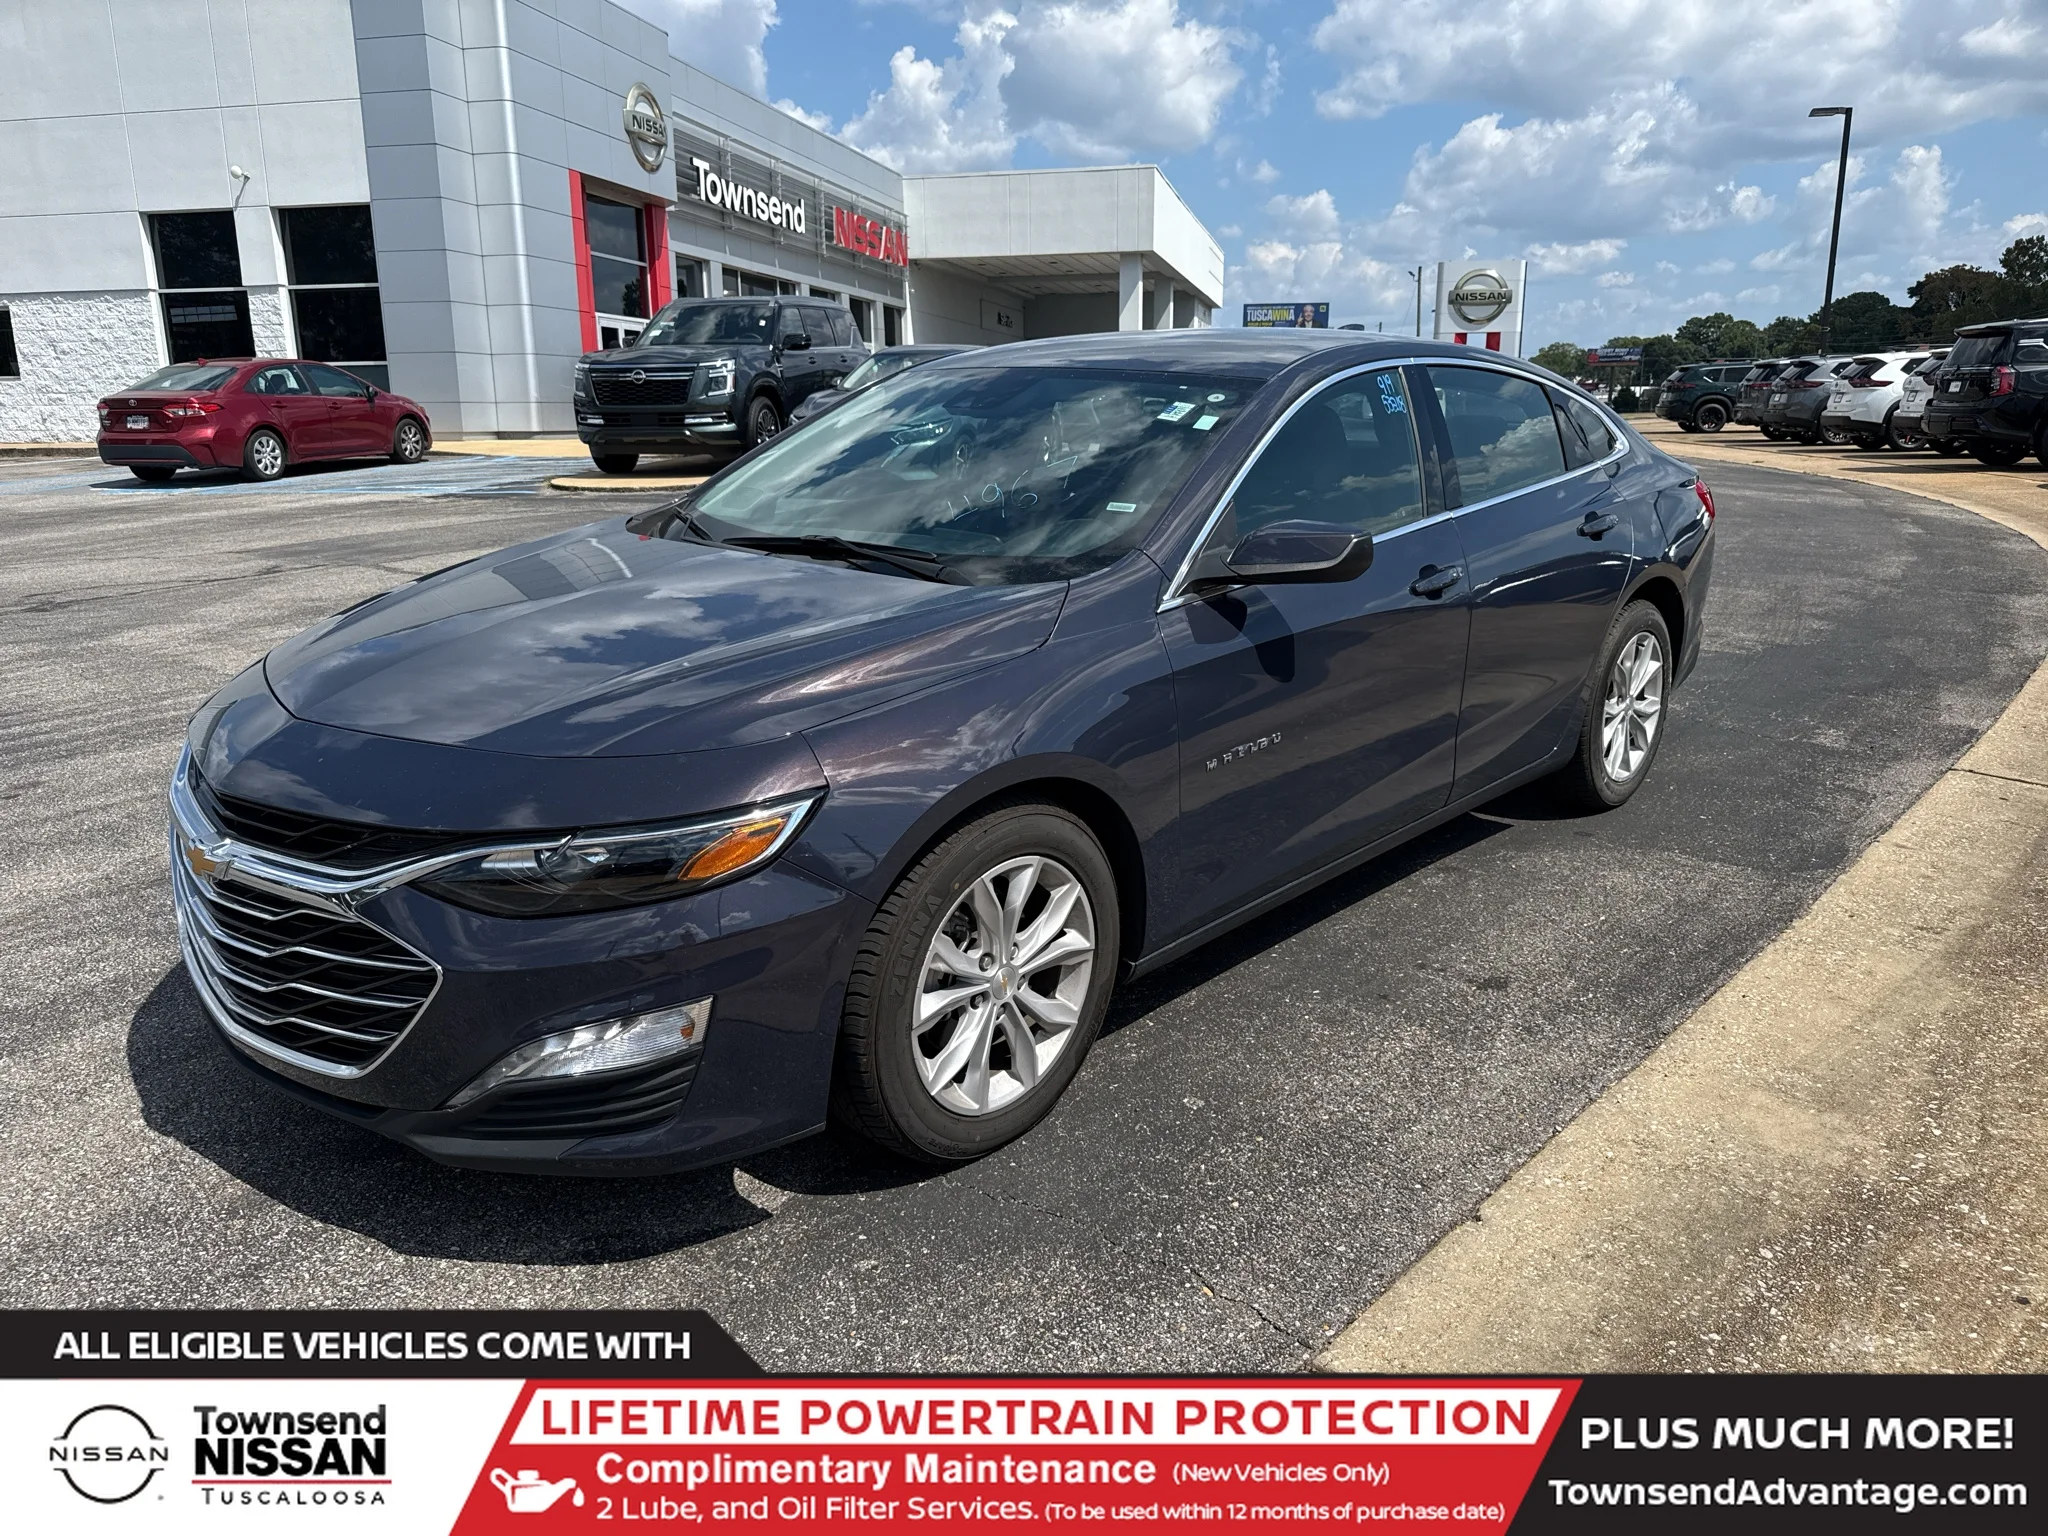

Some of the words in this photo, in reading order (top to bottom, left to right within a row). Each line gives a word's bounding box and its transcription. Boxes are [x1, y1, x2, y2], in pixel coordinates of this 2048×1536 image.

[691, 157, 806, 234] Townsend
[833, 206, 908, 268] NISSAN
[1246, 309, 1295, 322] TUSCAWINA
[1455, 292, 1507, 302] NISSAN
[1206, 732, 1282, 772] MALIBU
[891, 893, 944, 1001] ZENNA
